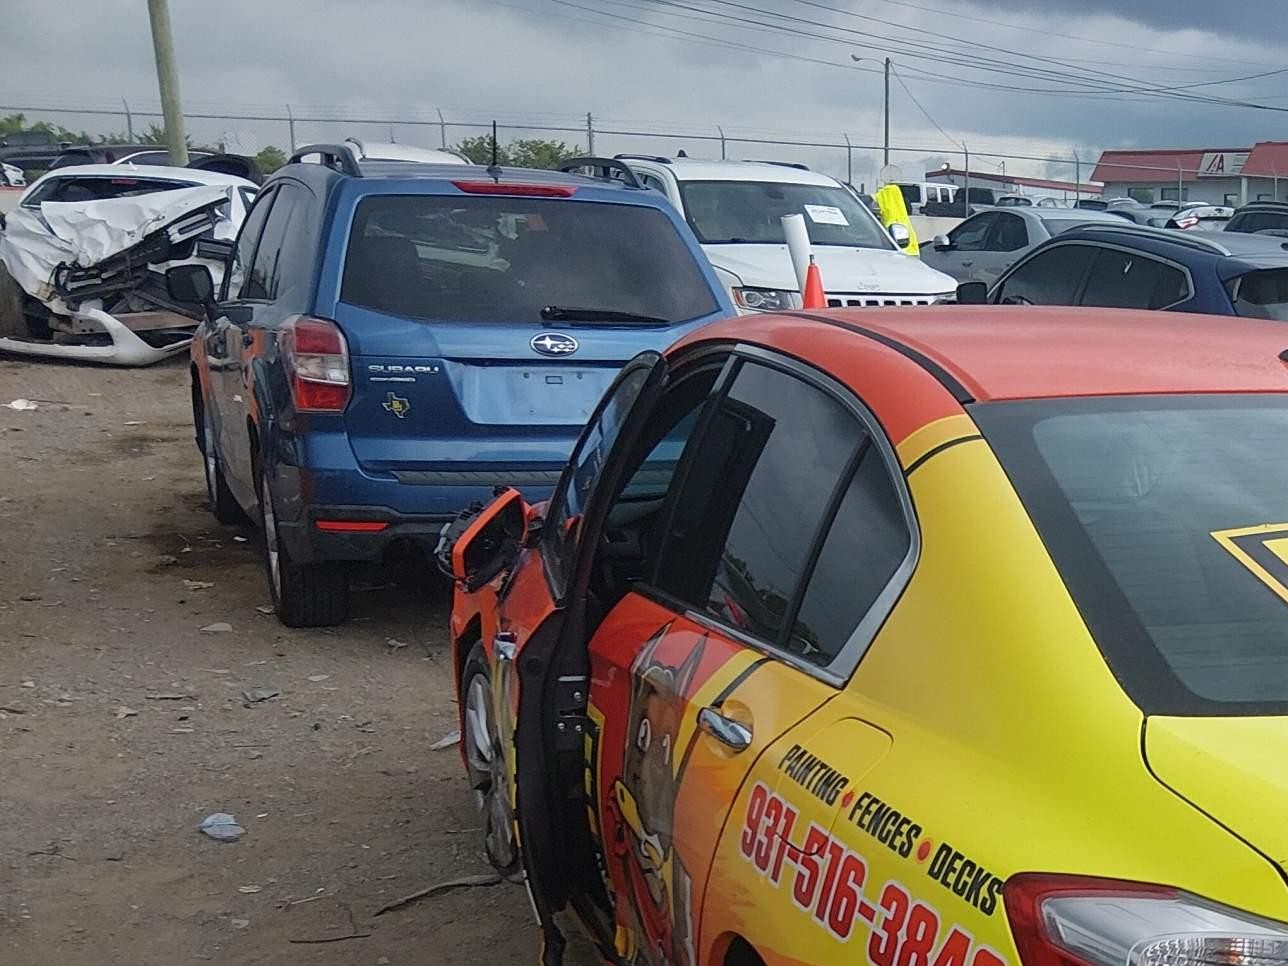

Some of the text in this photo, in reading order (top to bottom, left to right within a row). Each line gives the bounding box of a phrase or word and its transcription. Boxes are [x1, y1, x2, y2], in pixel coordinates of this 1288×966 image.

[368, 364, 440, 374] SUBARU
[777, 743, 1005, 917] PAINTING FENCES DECKS
